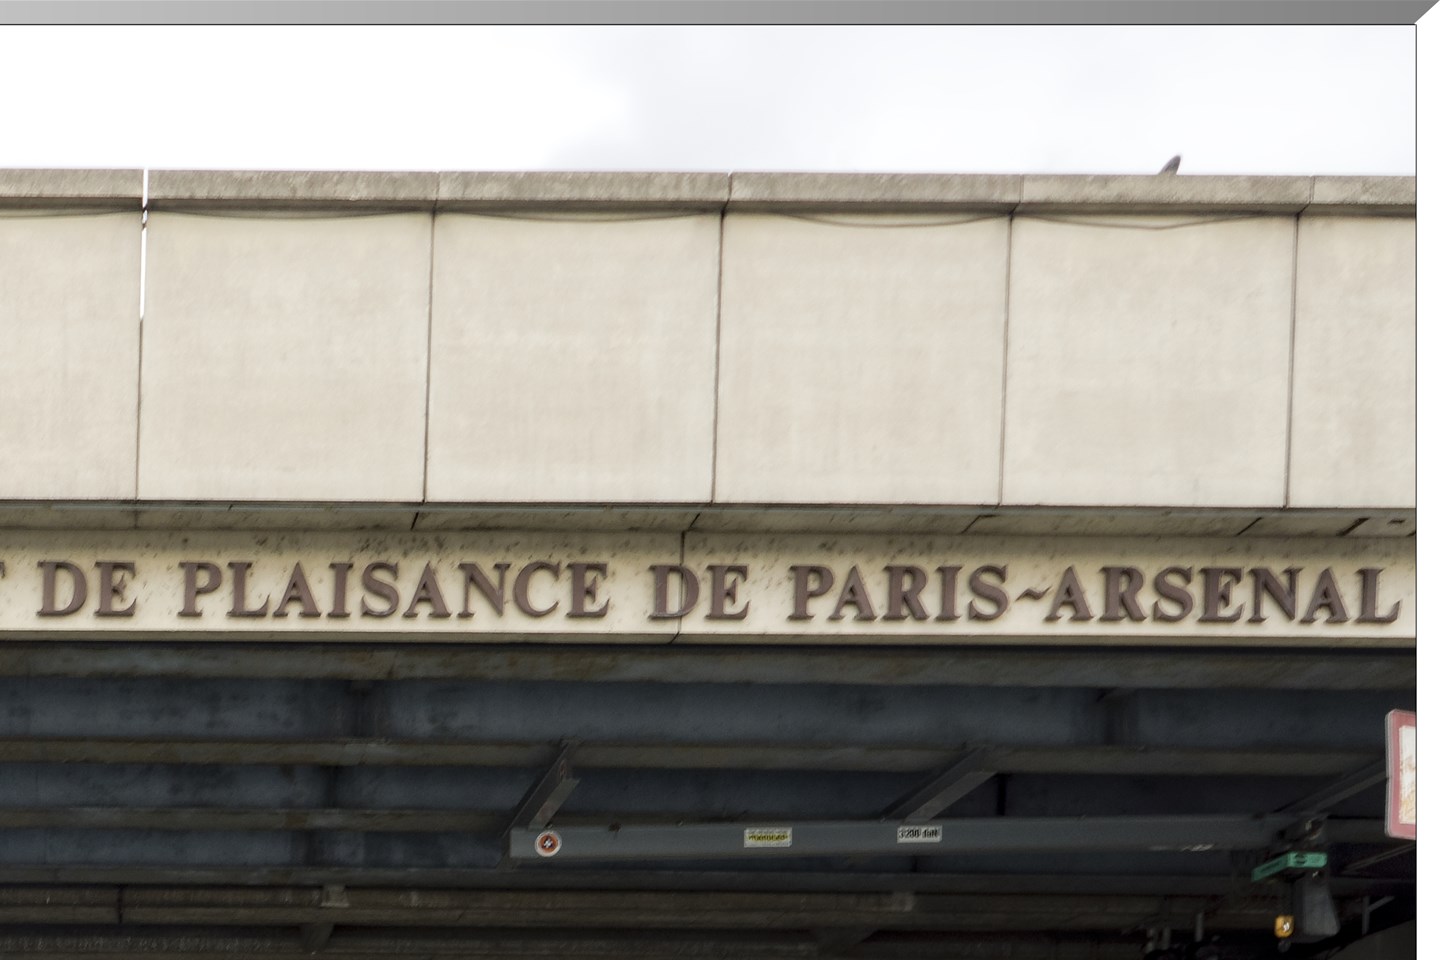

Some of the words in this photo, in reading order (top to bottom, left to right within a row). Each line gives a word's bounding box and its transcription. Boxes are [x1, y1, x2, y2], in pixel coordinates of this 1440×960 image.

[35, 560, 141, 619] DE
[178, 560, 612, 620] PLAISANCE
[648, 562, 751, 621] DE
